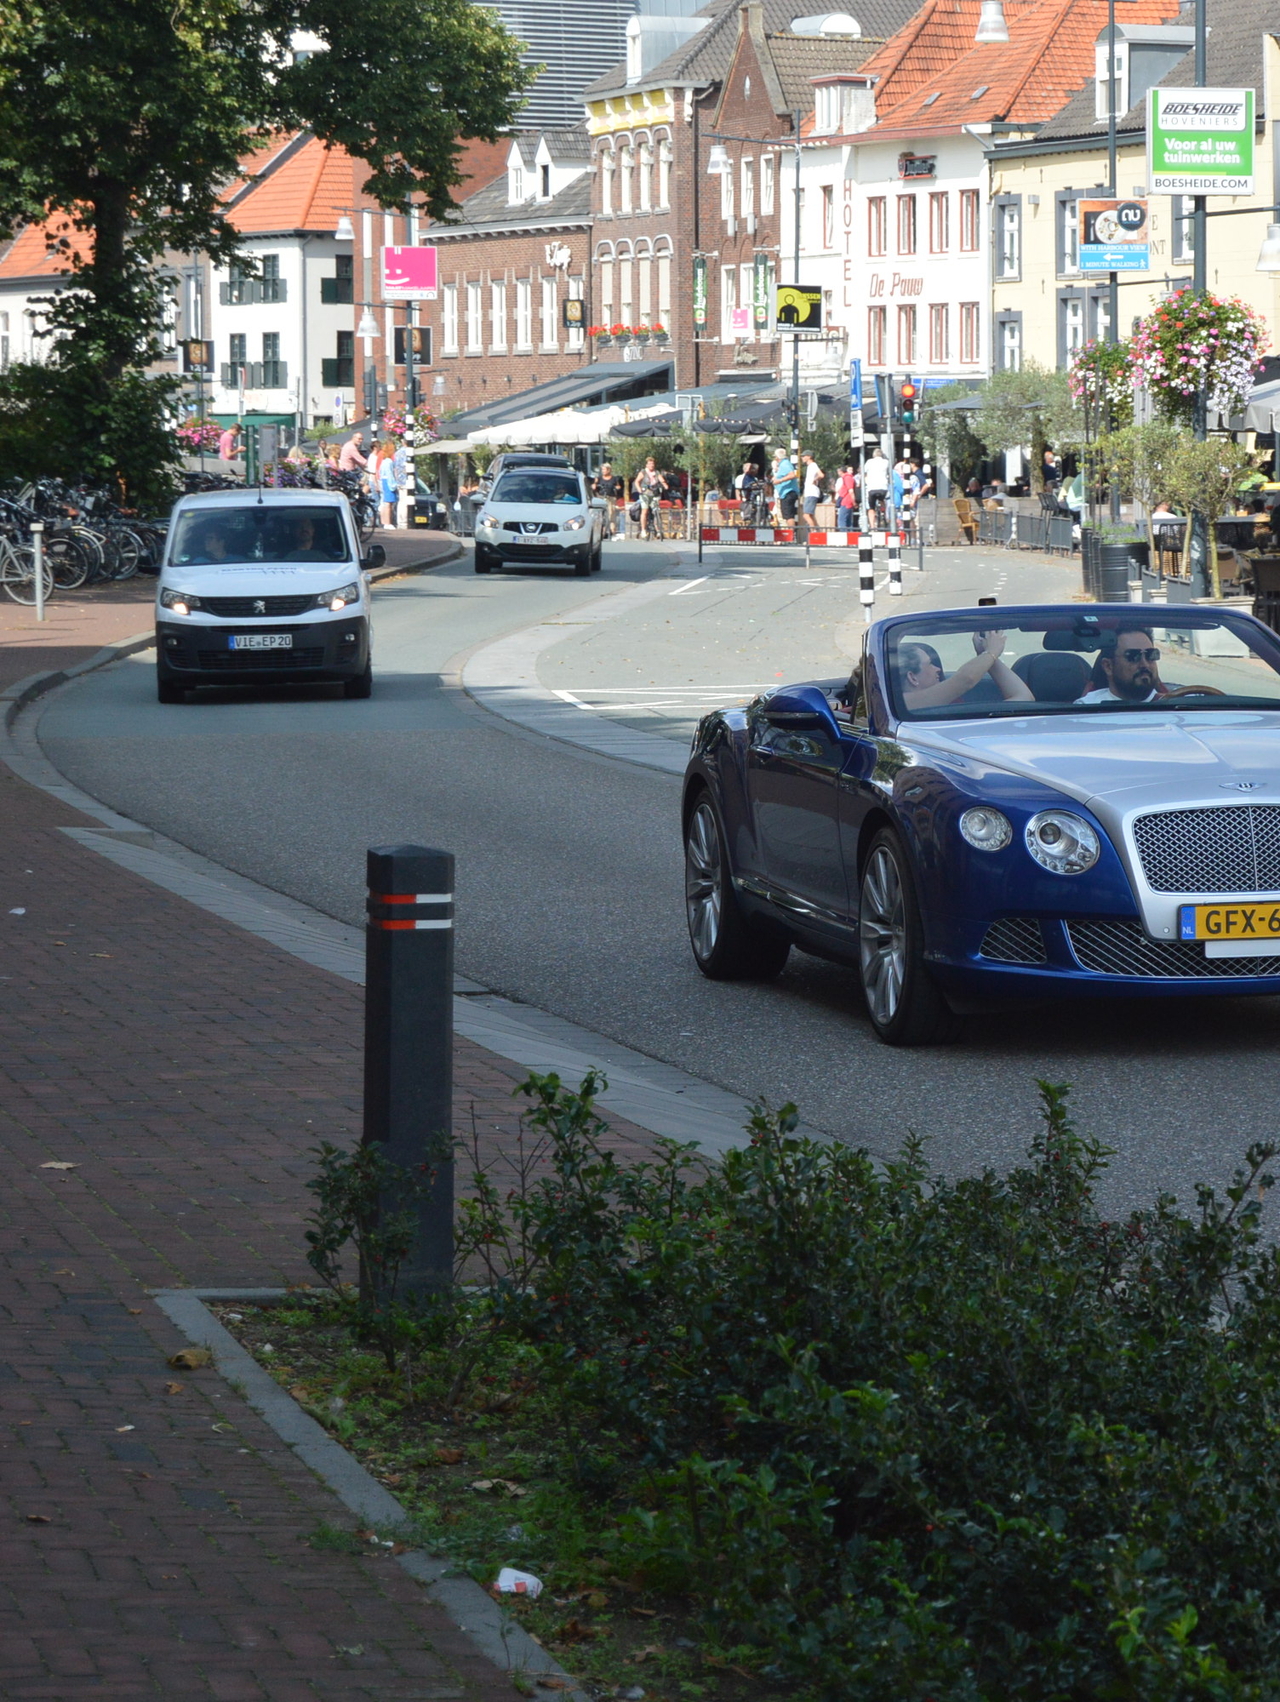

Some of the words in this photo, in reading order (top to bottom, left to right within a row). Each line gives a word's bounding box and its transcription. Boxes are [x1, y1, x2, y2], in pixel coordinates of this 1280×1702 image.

[1162, 102, 1244, 116] BOESHEIDE
[1161, 117, 1238, 126] HOVENIERS
[1164, 138, 1197, 150] Voor
[1200, 138, 1212, 150] al
[1216, 141, 1236, 150] uw
[1163, 151, 1240, 163] tuinwerken
[1155, 178, 1248, 188] BOESHEIDE.COM
[844, 179, 852, 307] HOTEL
[870, 274, 884, 298] De
[890, 272, 923, 297] Pauw
[235, 637, 256, 647] VIE
[262, 636, 276, 646] EP
[278, 636, 290, 646] 20
[1182, 926, 1194, 934] NL
